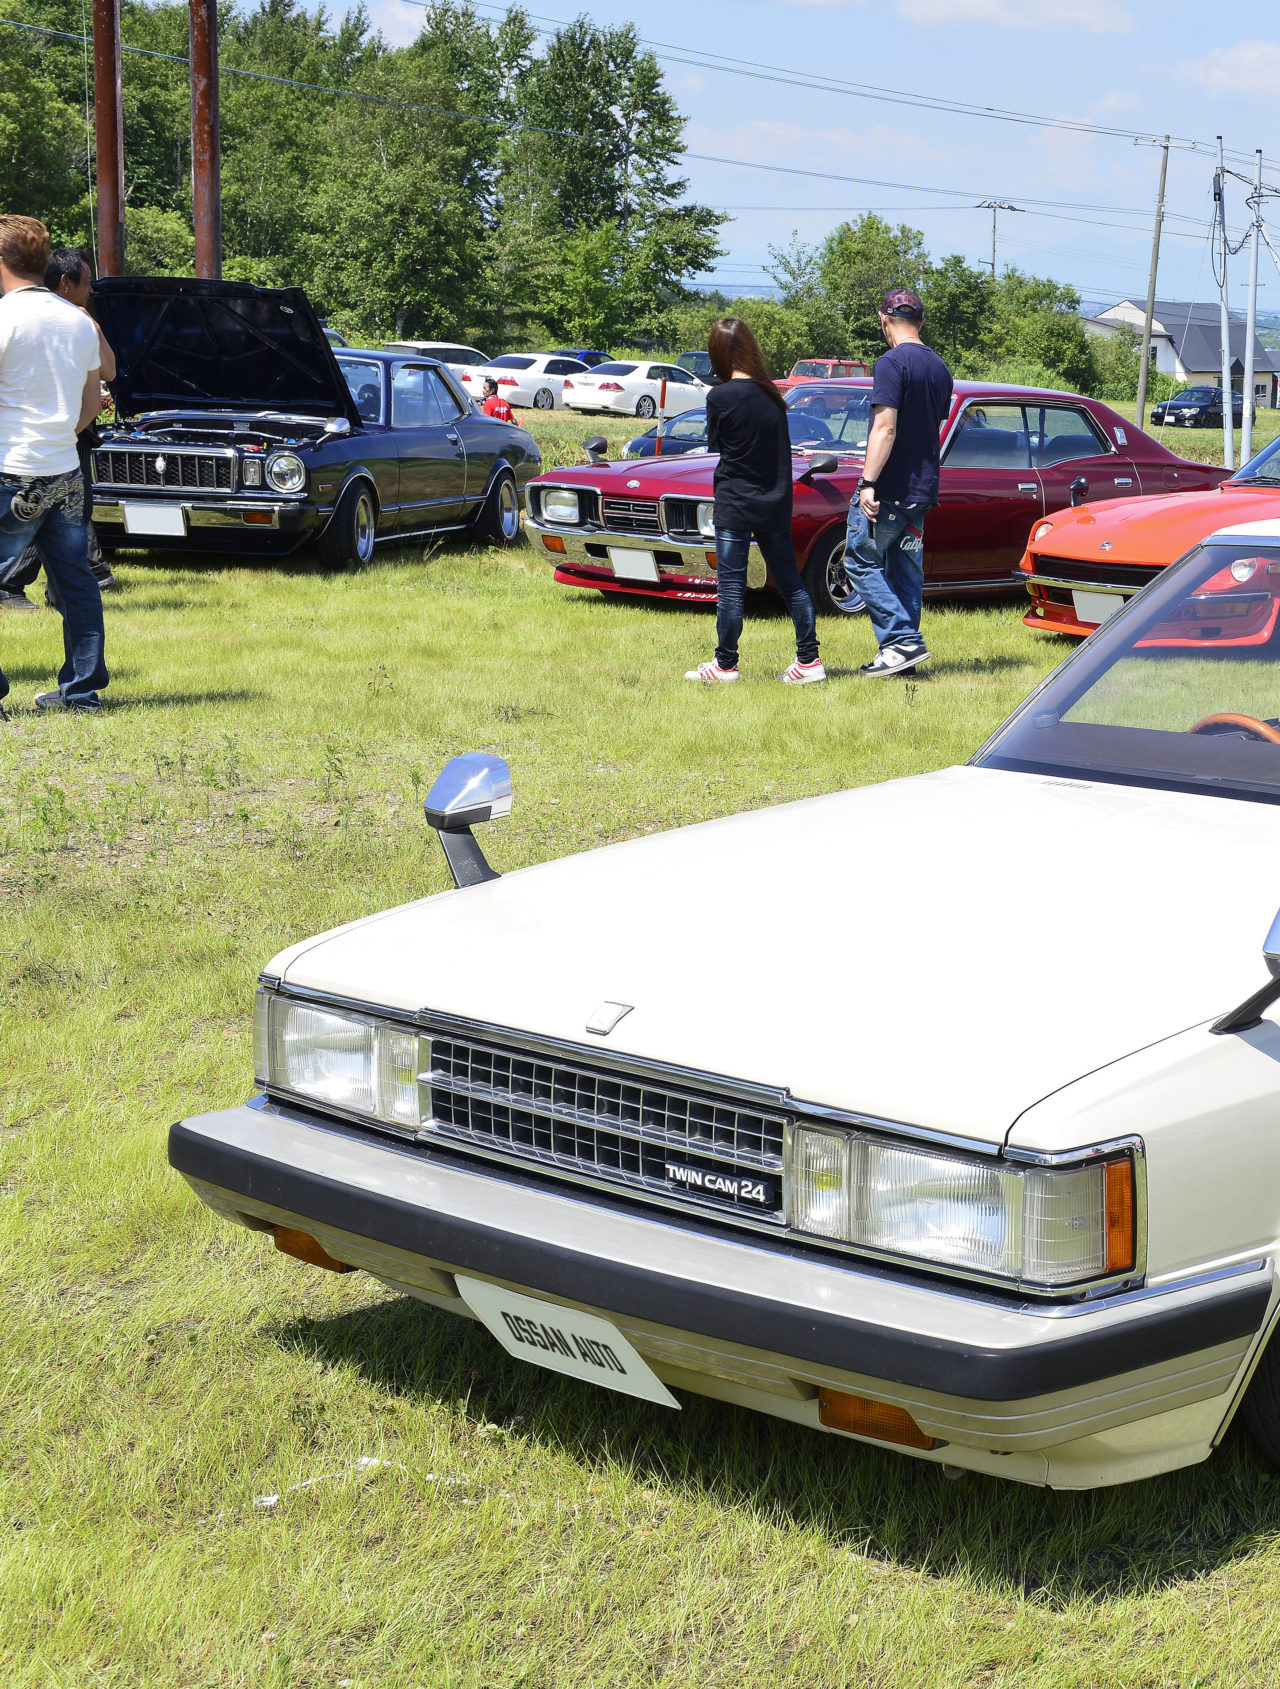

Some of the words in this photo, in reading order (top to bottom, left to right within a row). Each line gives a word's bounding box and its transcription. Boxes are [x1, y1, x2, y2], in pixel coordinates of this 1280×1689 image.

[664, 1162, 703, 1186] TWIN
[704, 1174, 739, 1195] CAM
[740, 1179, 766, 1202] 24
[500, 1310, 578, 1360] OSSAN
[570, 1333, 628, 1375] AUTO
